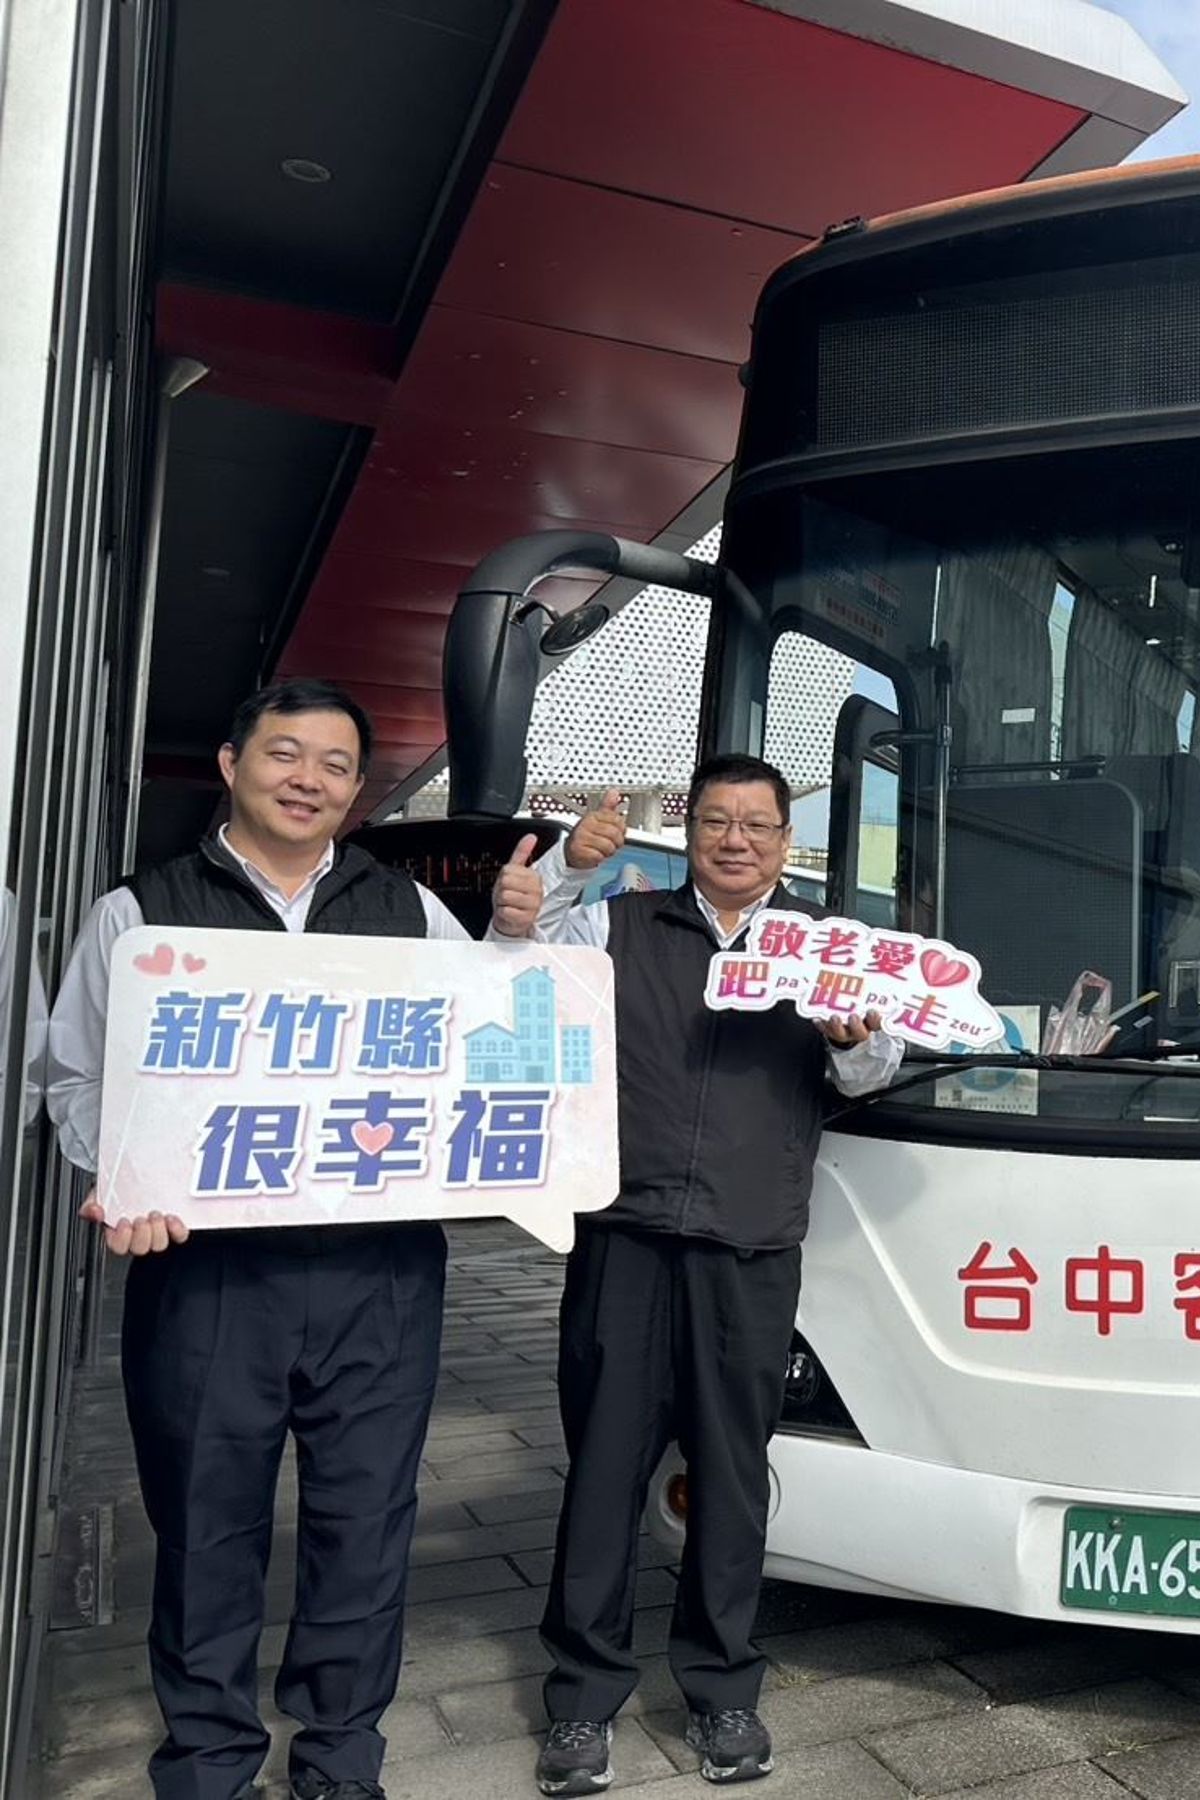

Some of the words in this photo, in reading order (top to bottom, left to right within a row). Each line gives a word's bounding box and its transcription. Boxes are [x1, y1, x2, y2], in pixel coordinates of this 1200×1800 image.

[759, 919, 916, 981] 敬老愛
[143, 991, 447, 1069] 新竹縣
[893, 994, 947, 1037] 走
[196, 1090, 550, 1191] 很幸福
